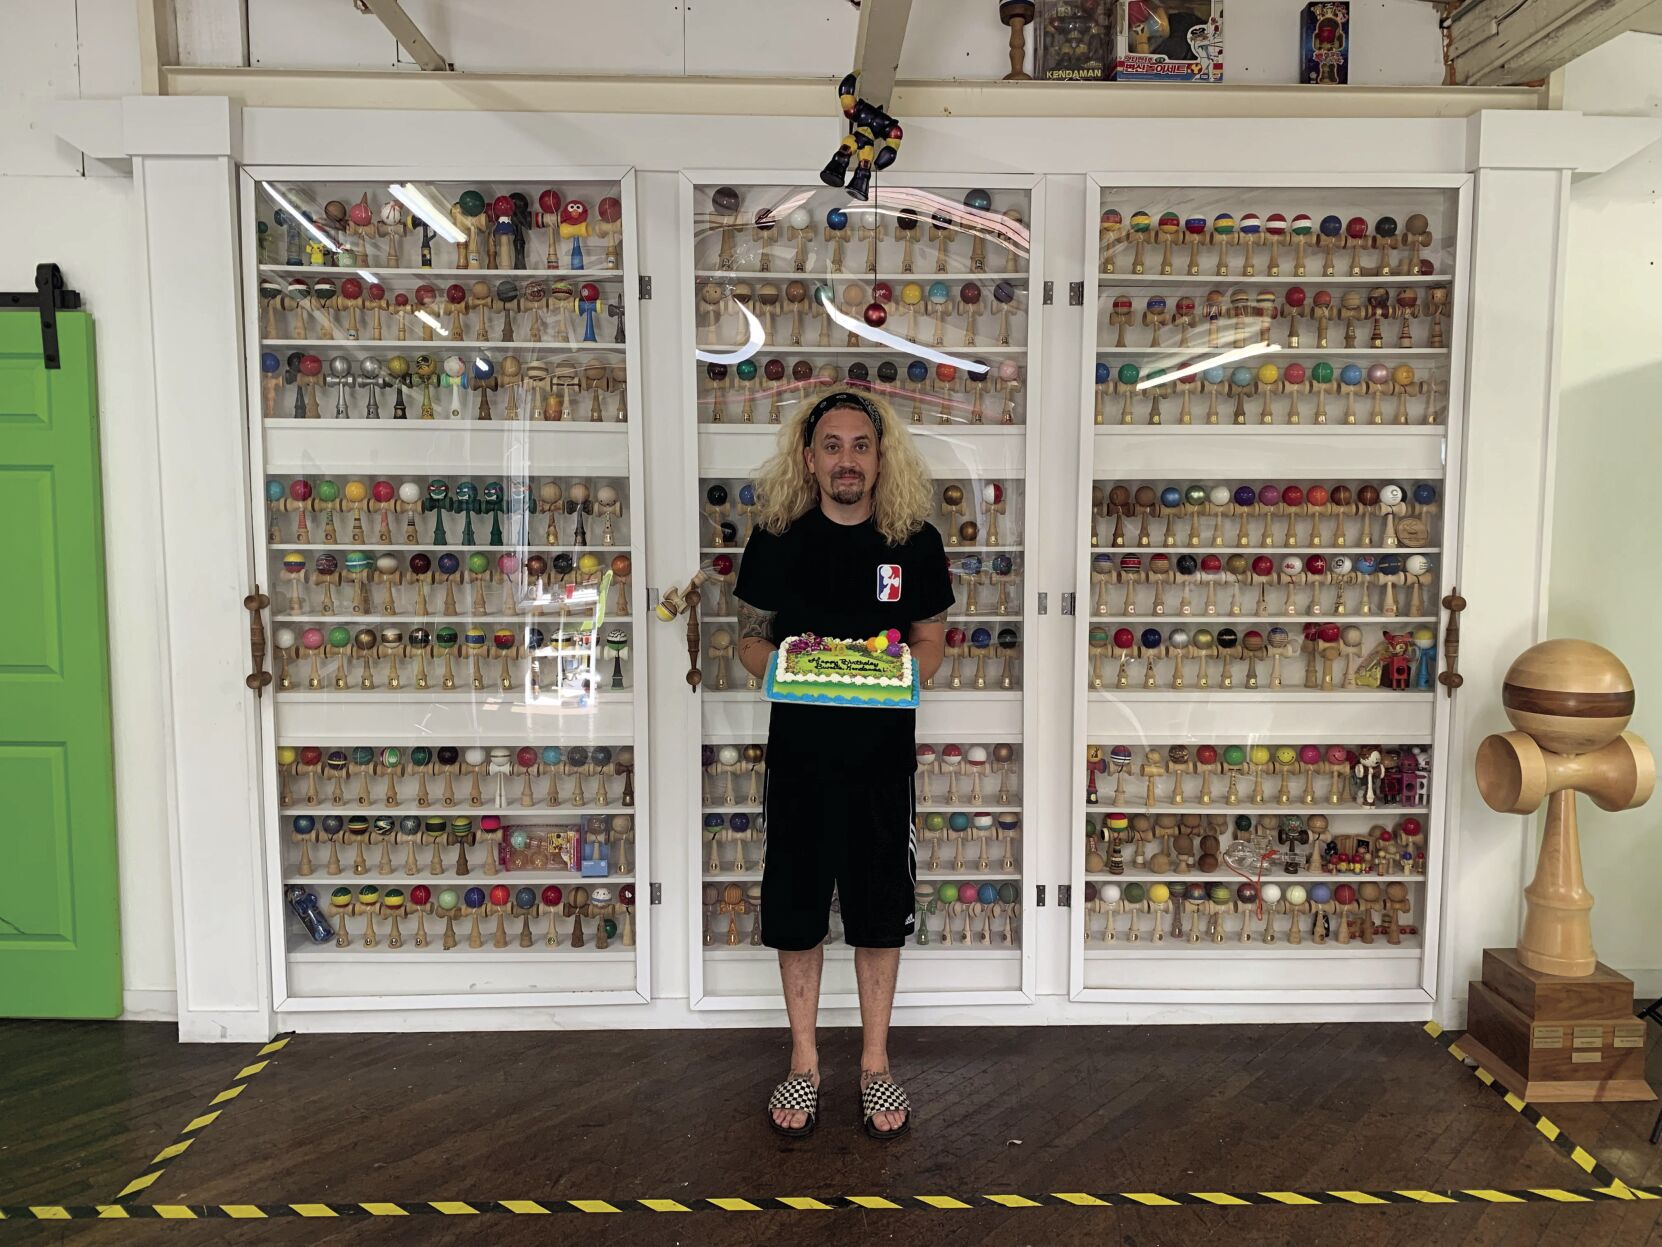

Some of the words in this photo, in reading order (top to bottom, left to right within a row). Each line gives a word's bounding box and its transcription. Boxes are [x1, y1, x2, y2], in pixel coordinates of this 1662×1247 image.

[1046, 69, 1102, 79] KENDAMAN
[808, 657, 839, 667] Happy
[839, 658, 879, 667] Birthday
